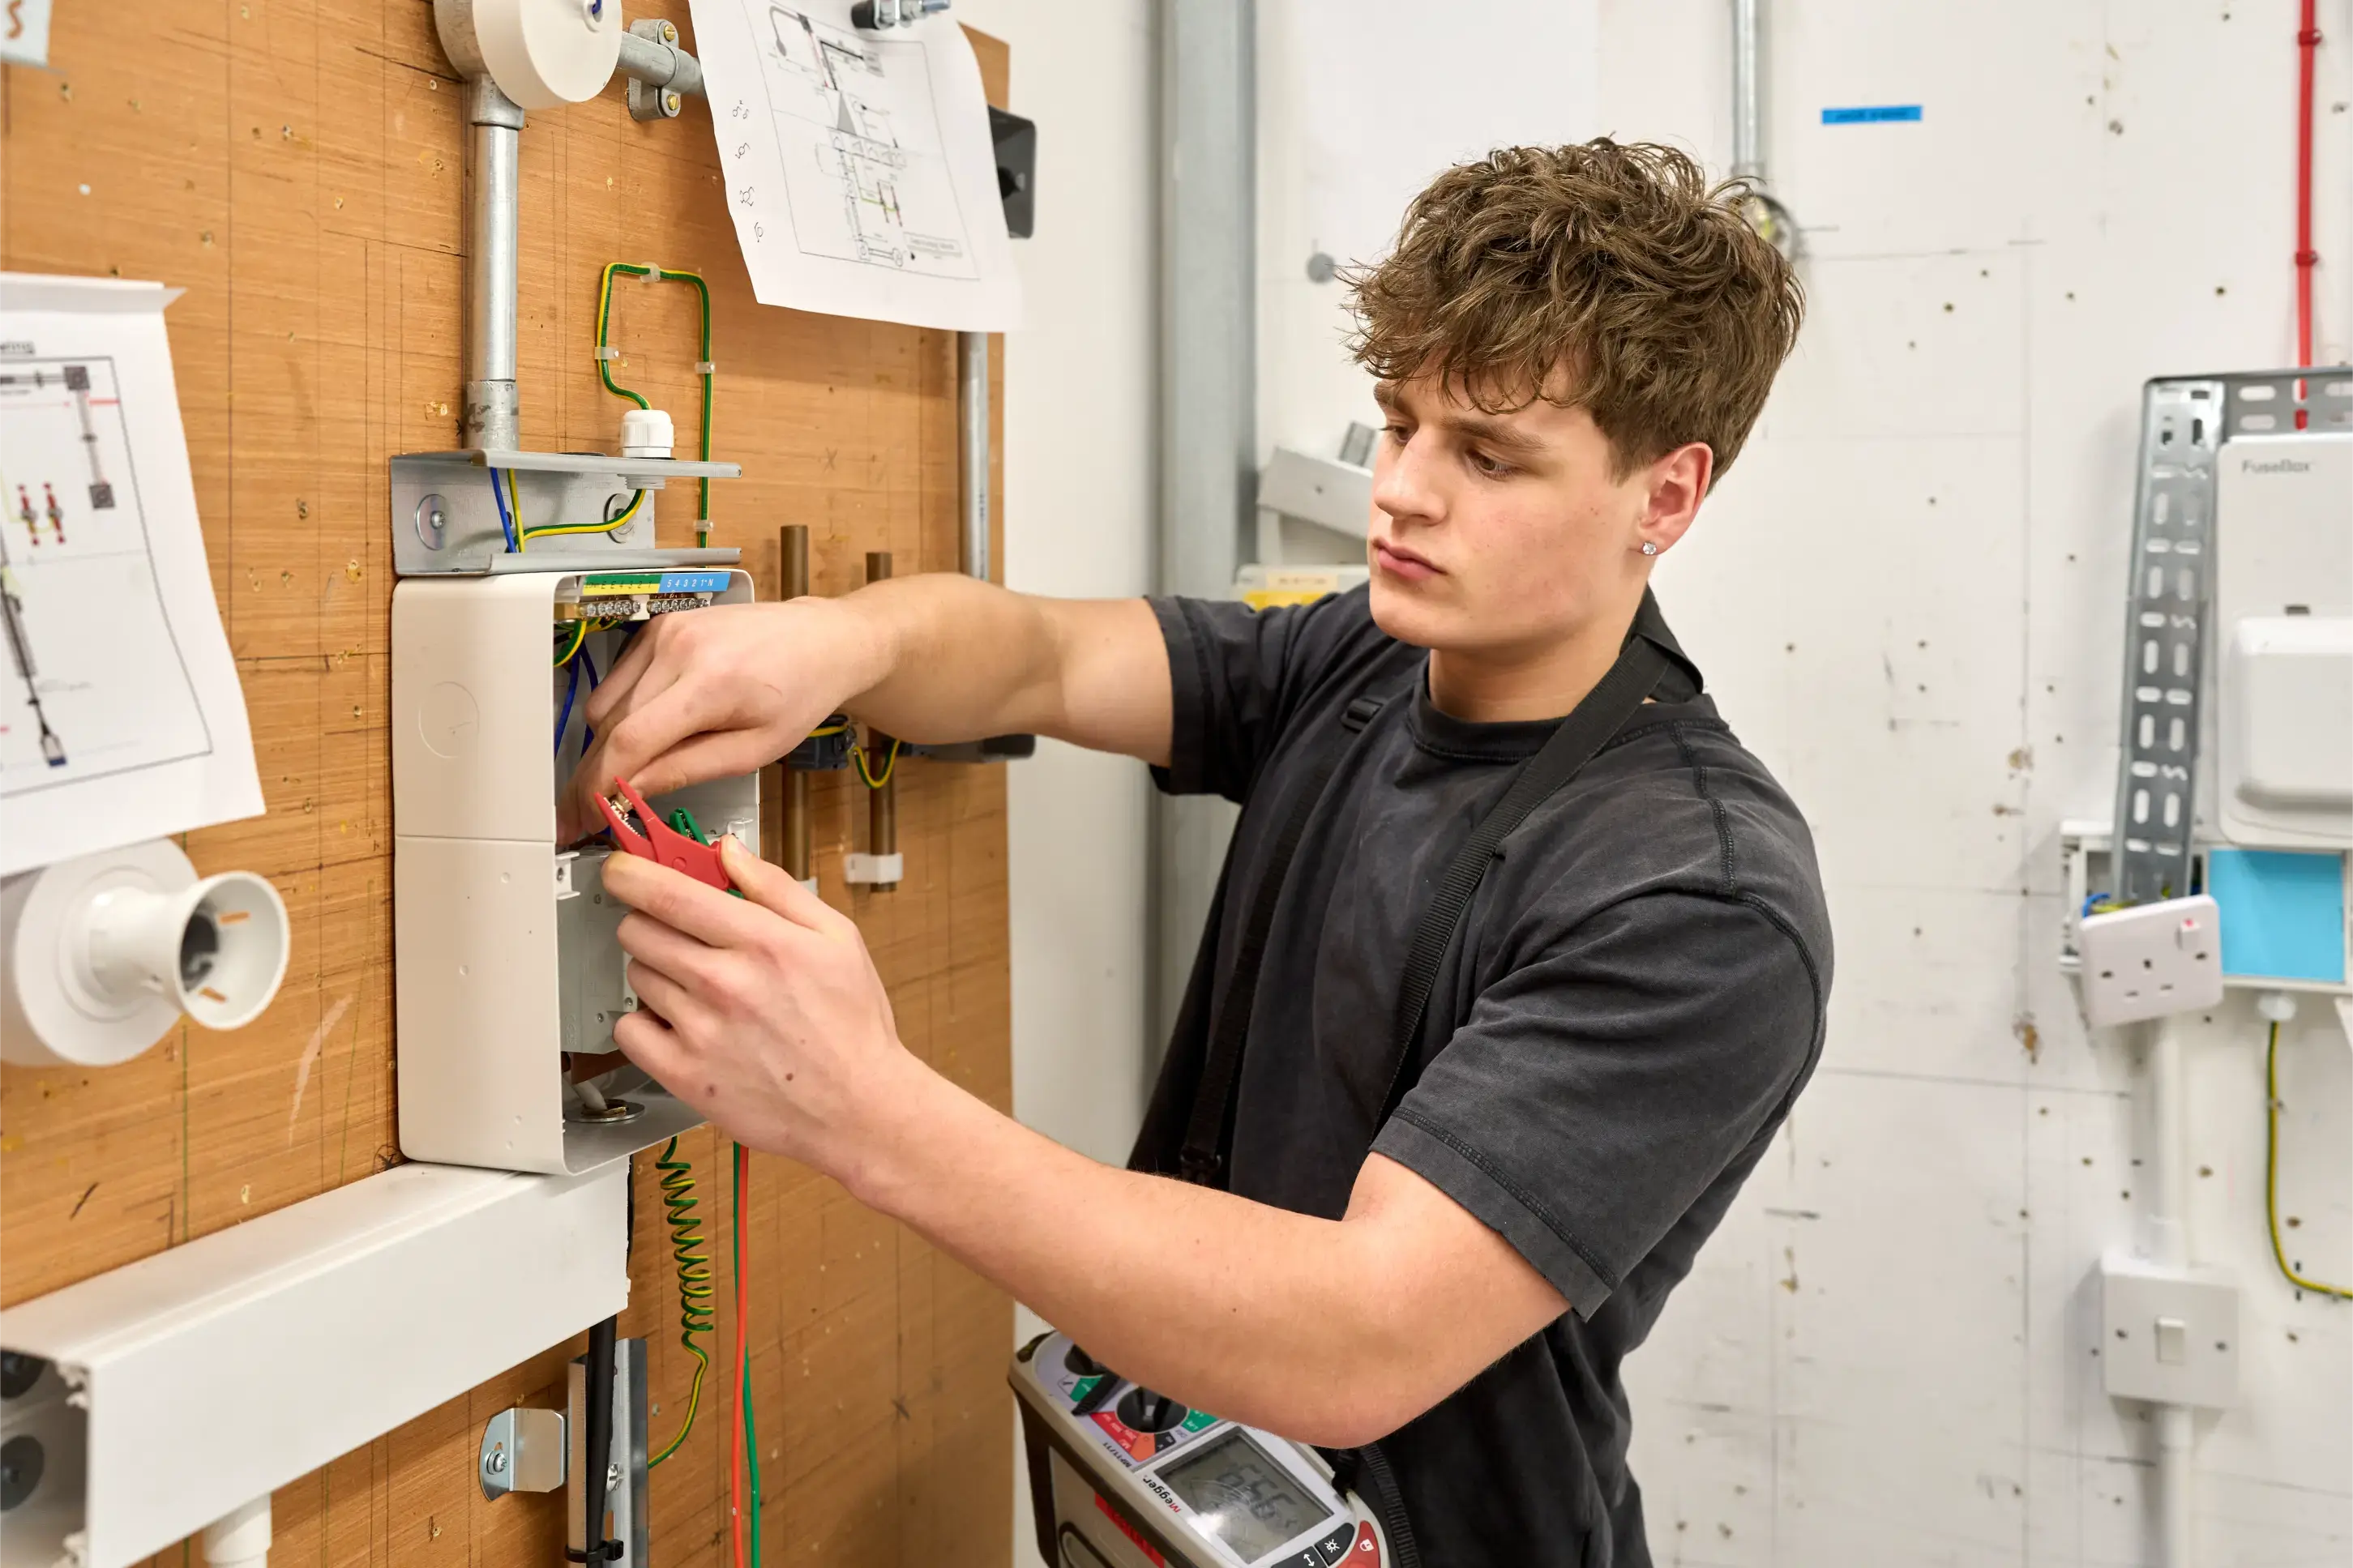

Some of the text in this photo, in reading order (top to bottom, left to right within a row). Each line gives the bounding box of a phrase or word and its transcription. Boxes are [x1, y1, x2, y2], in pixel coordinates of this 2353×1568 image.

[2241, 459, 2310, 474] FuseBox
[667, 579, 673, 588] 5
[675, 579, 680, 587] 4
[683, 579, 689, 587] 3
[691, 579, 697, 587] 2
[1142, 1476, 1182, 1514] Megger
